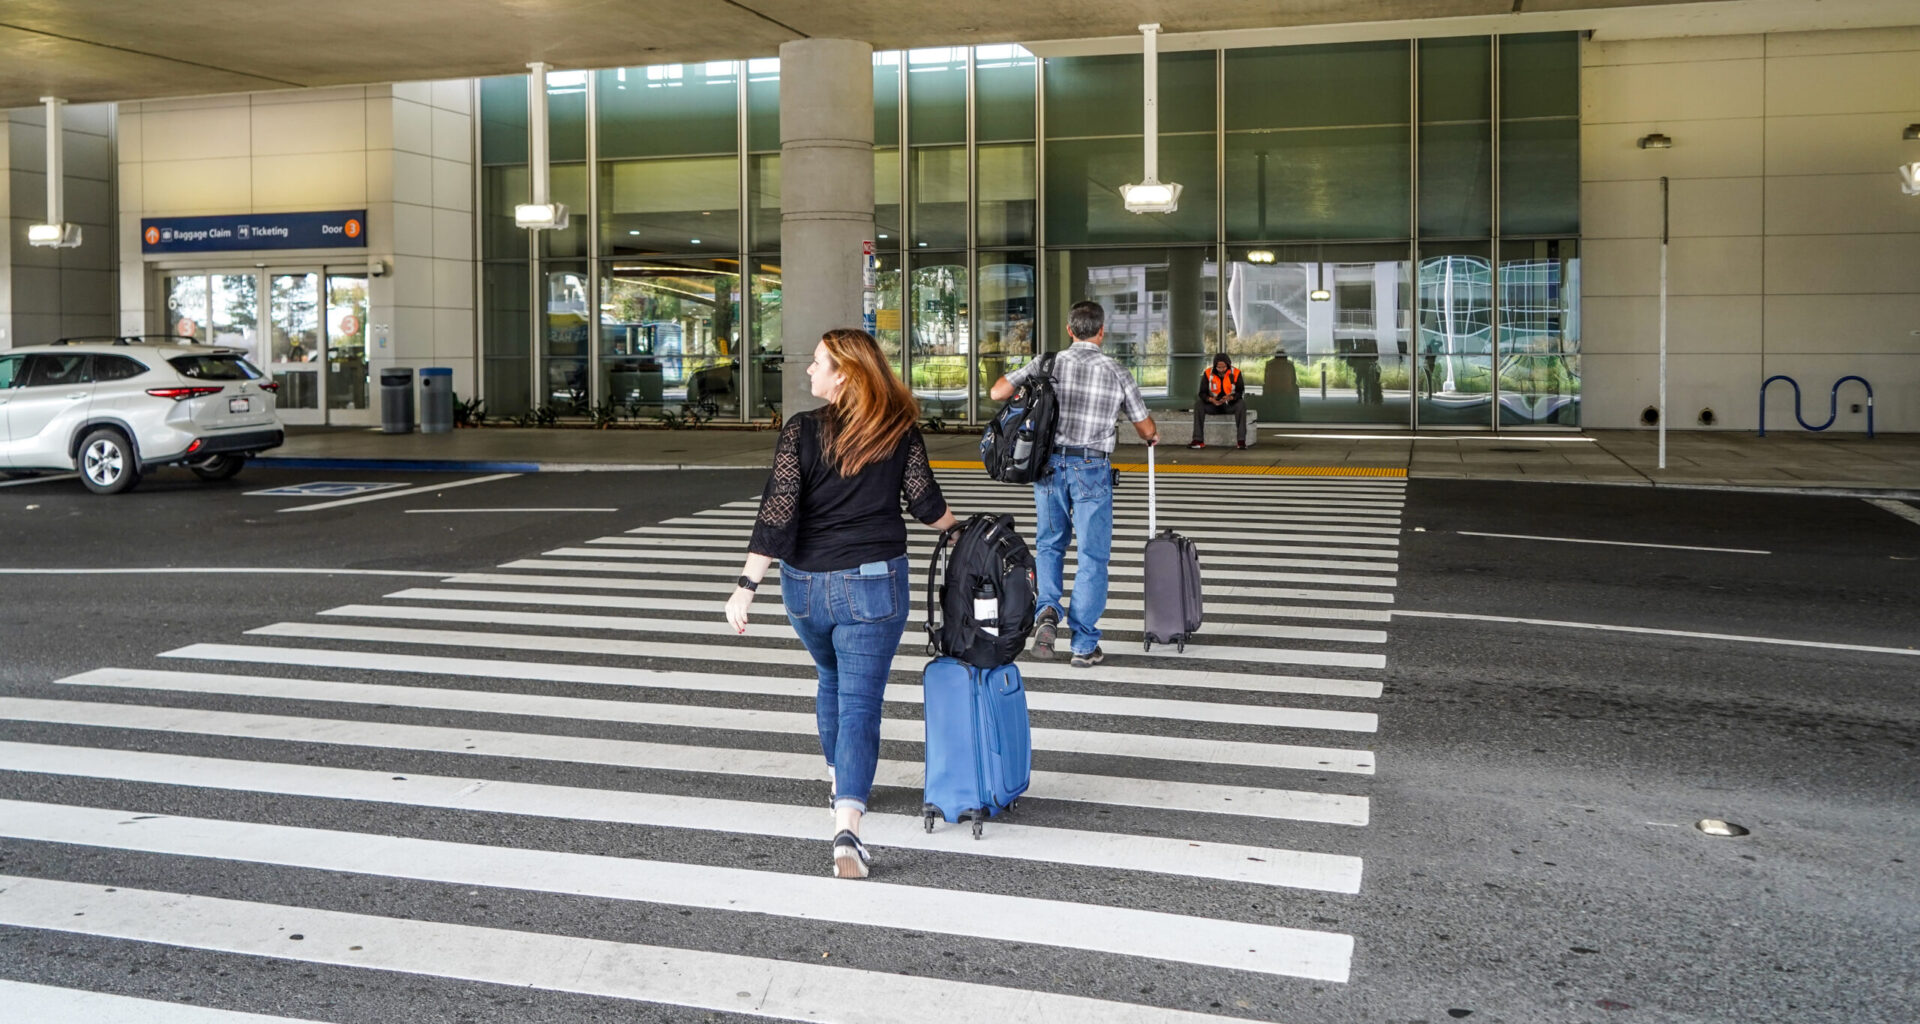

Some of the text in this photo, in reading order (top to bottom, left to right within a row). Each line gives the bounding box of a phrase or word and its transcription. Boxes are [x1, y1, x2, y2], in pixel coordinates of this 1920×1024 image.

[173, 228, 232, 241] Baggage Claim
[251, 226, 289, 238] Ticketing
[322, 222, 356, 234] Door 3
[183, 320, 193, 335] 3
[344, 317, 355, 334] 3
